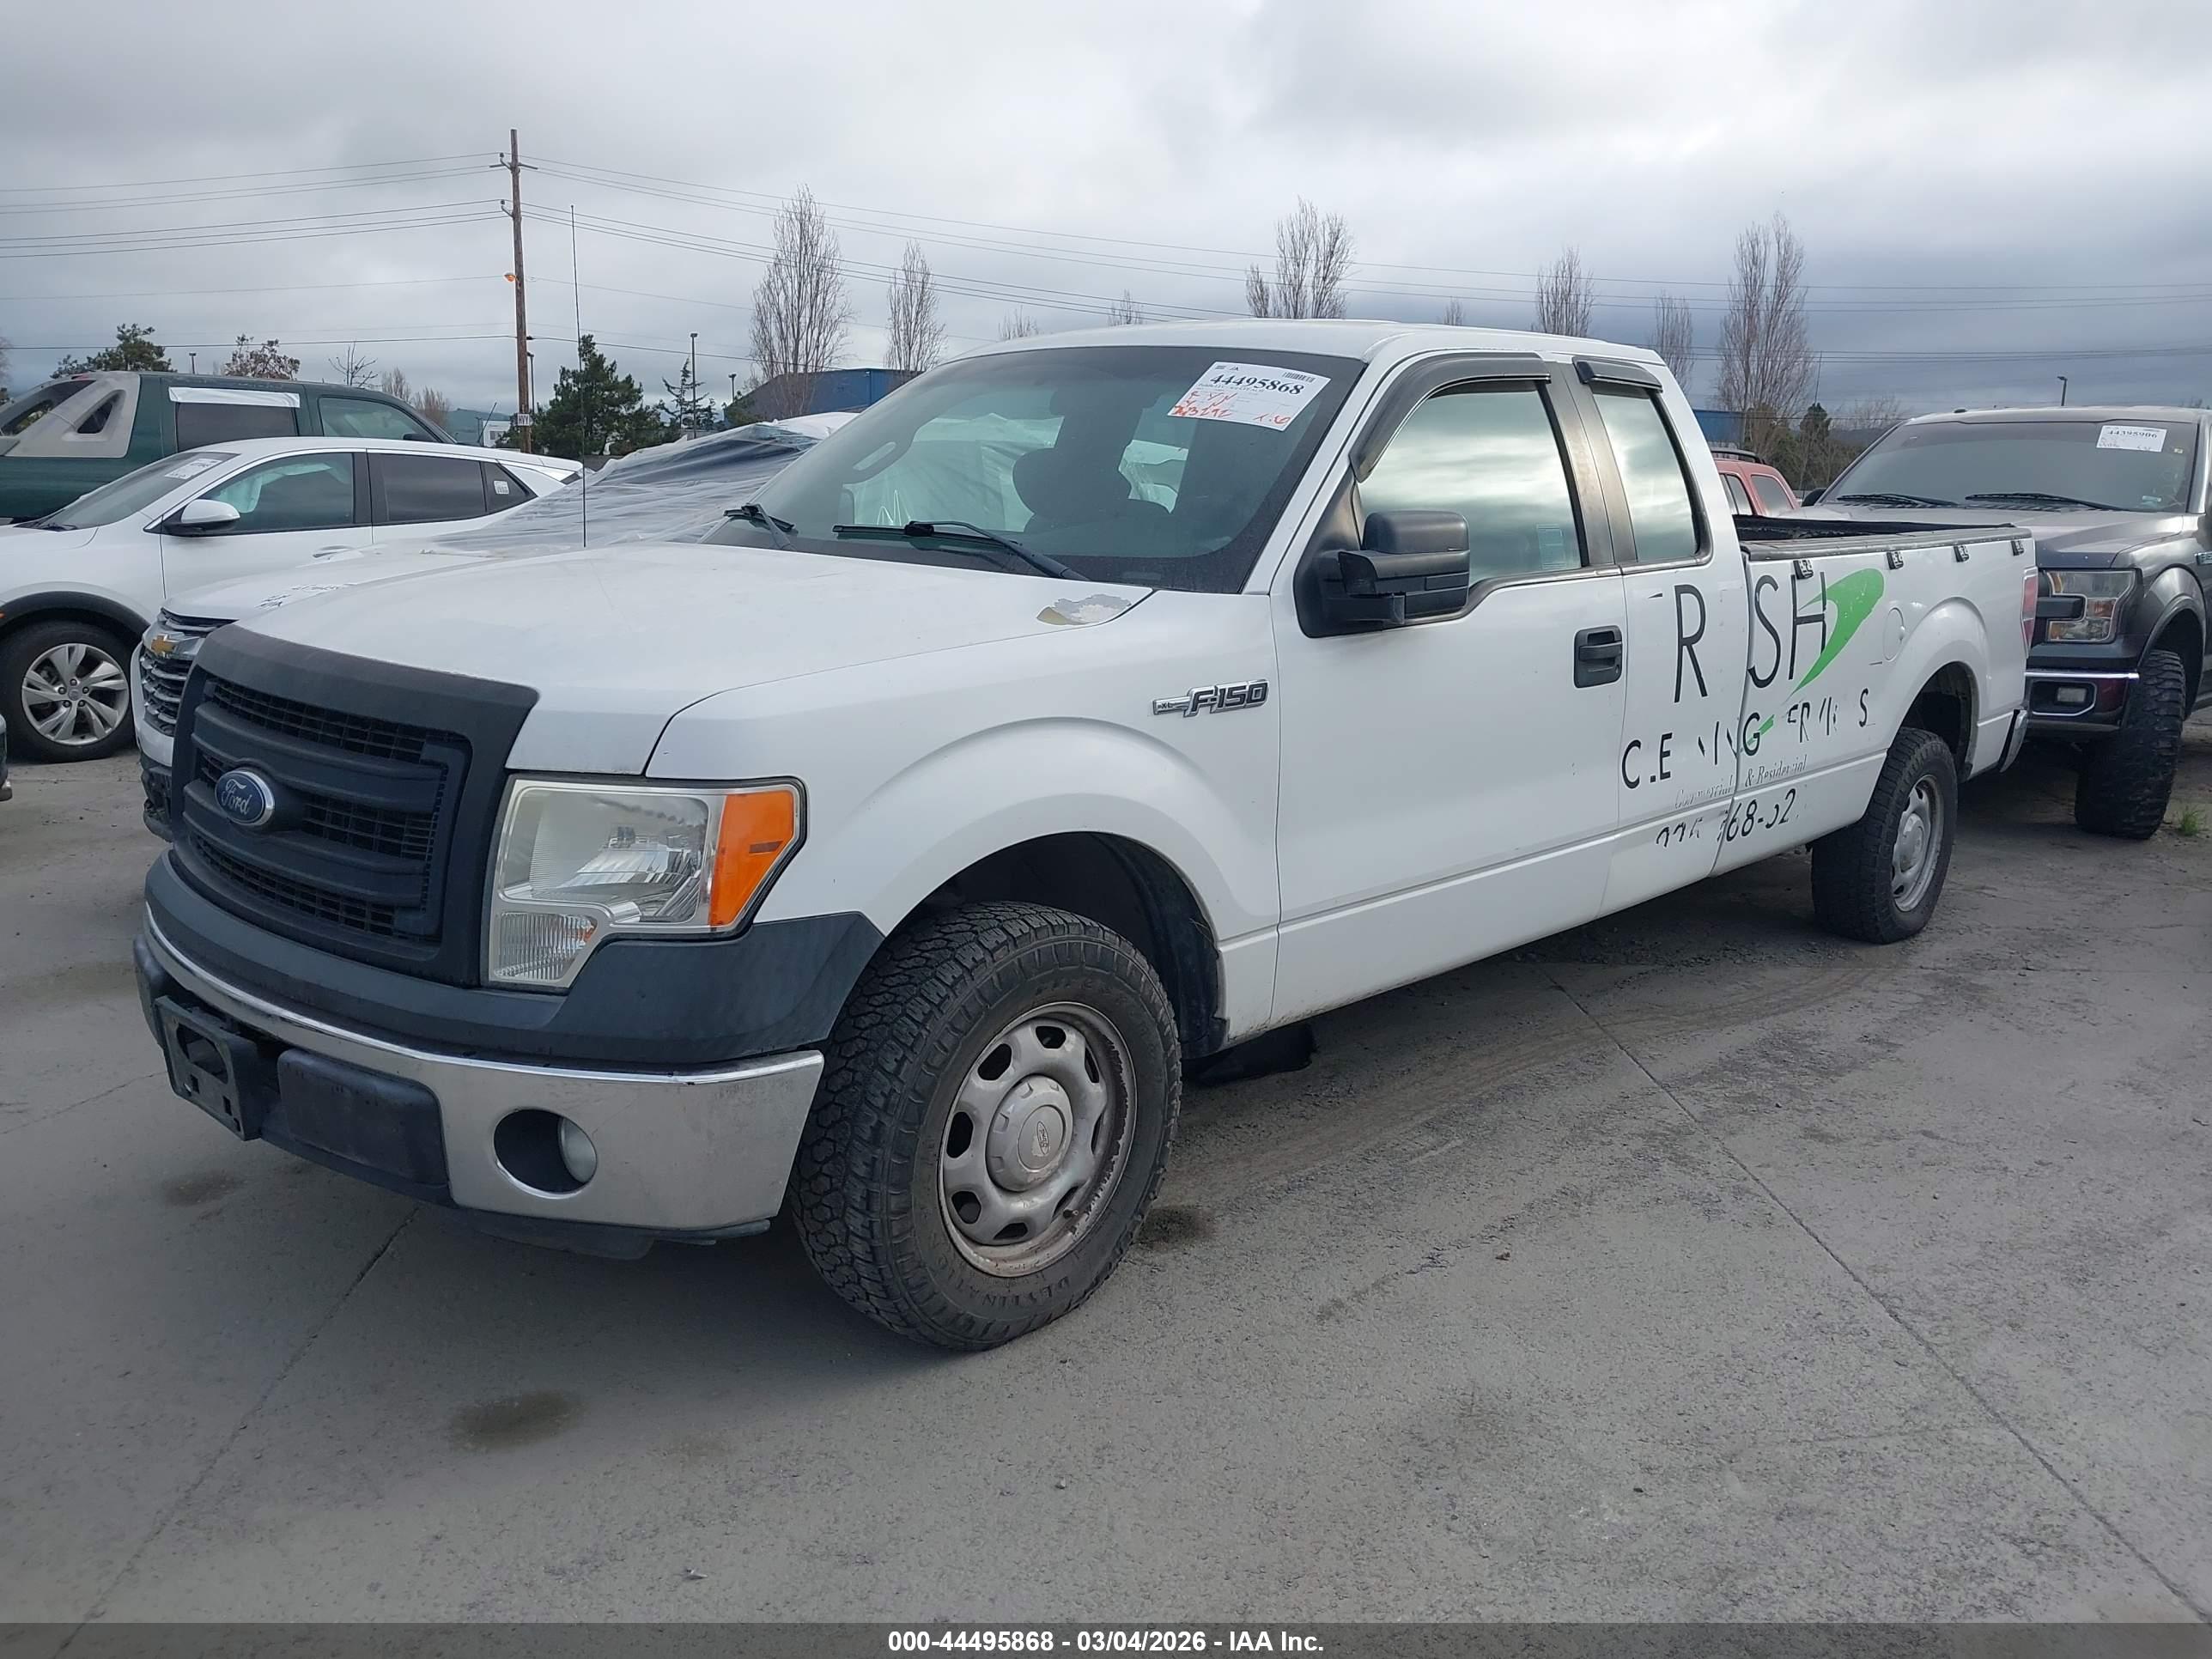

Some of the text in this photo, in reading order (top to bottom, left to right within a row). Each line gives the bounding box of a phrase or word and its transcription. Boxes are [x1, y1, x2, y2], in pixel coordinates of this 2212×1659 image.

[1210, 374, 1304, 395] 44495868
[1187, 679, 1269, 716] F-150
[221, 778, 252, 816] Ford
